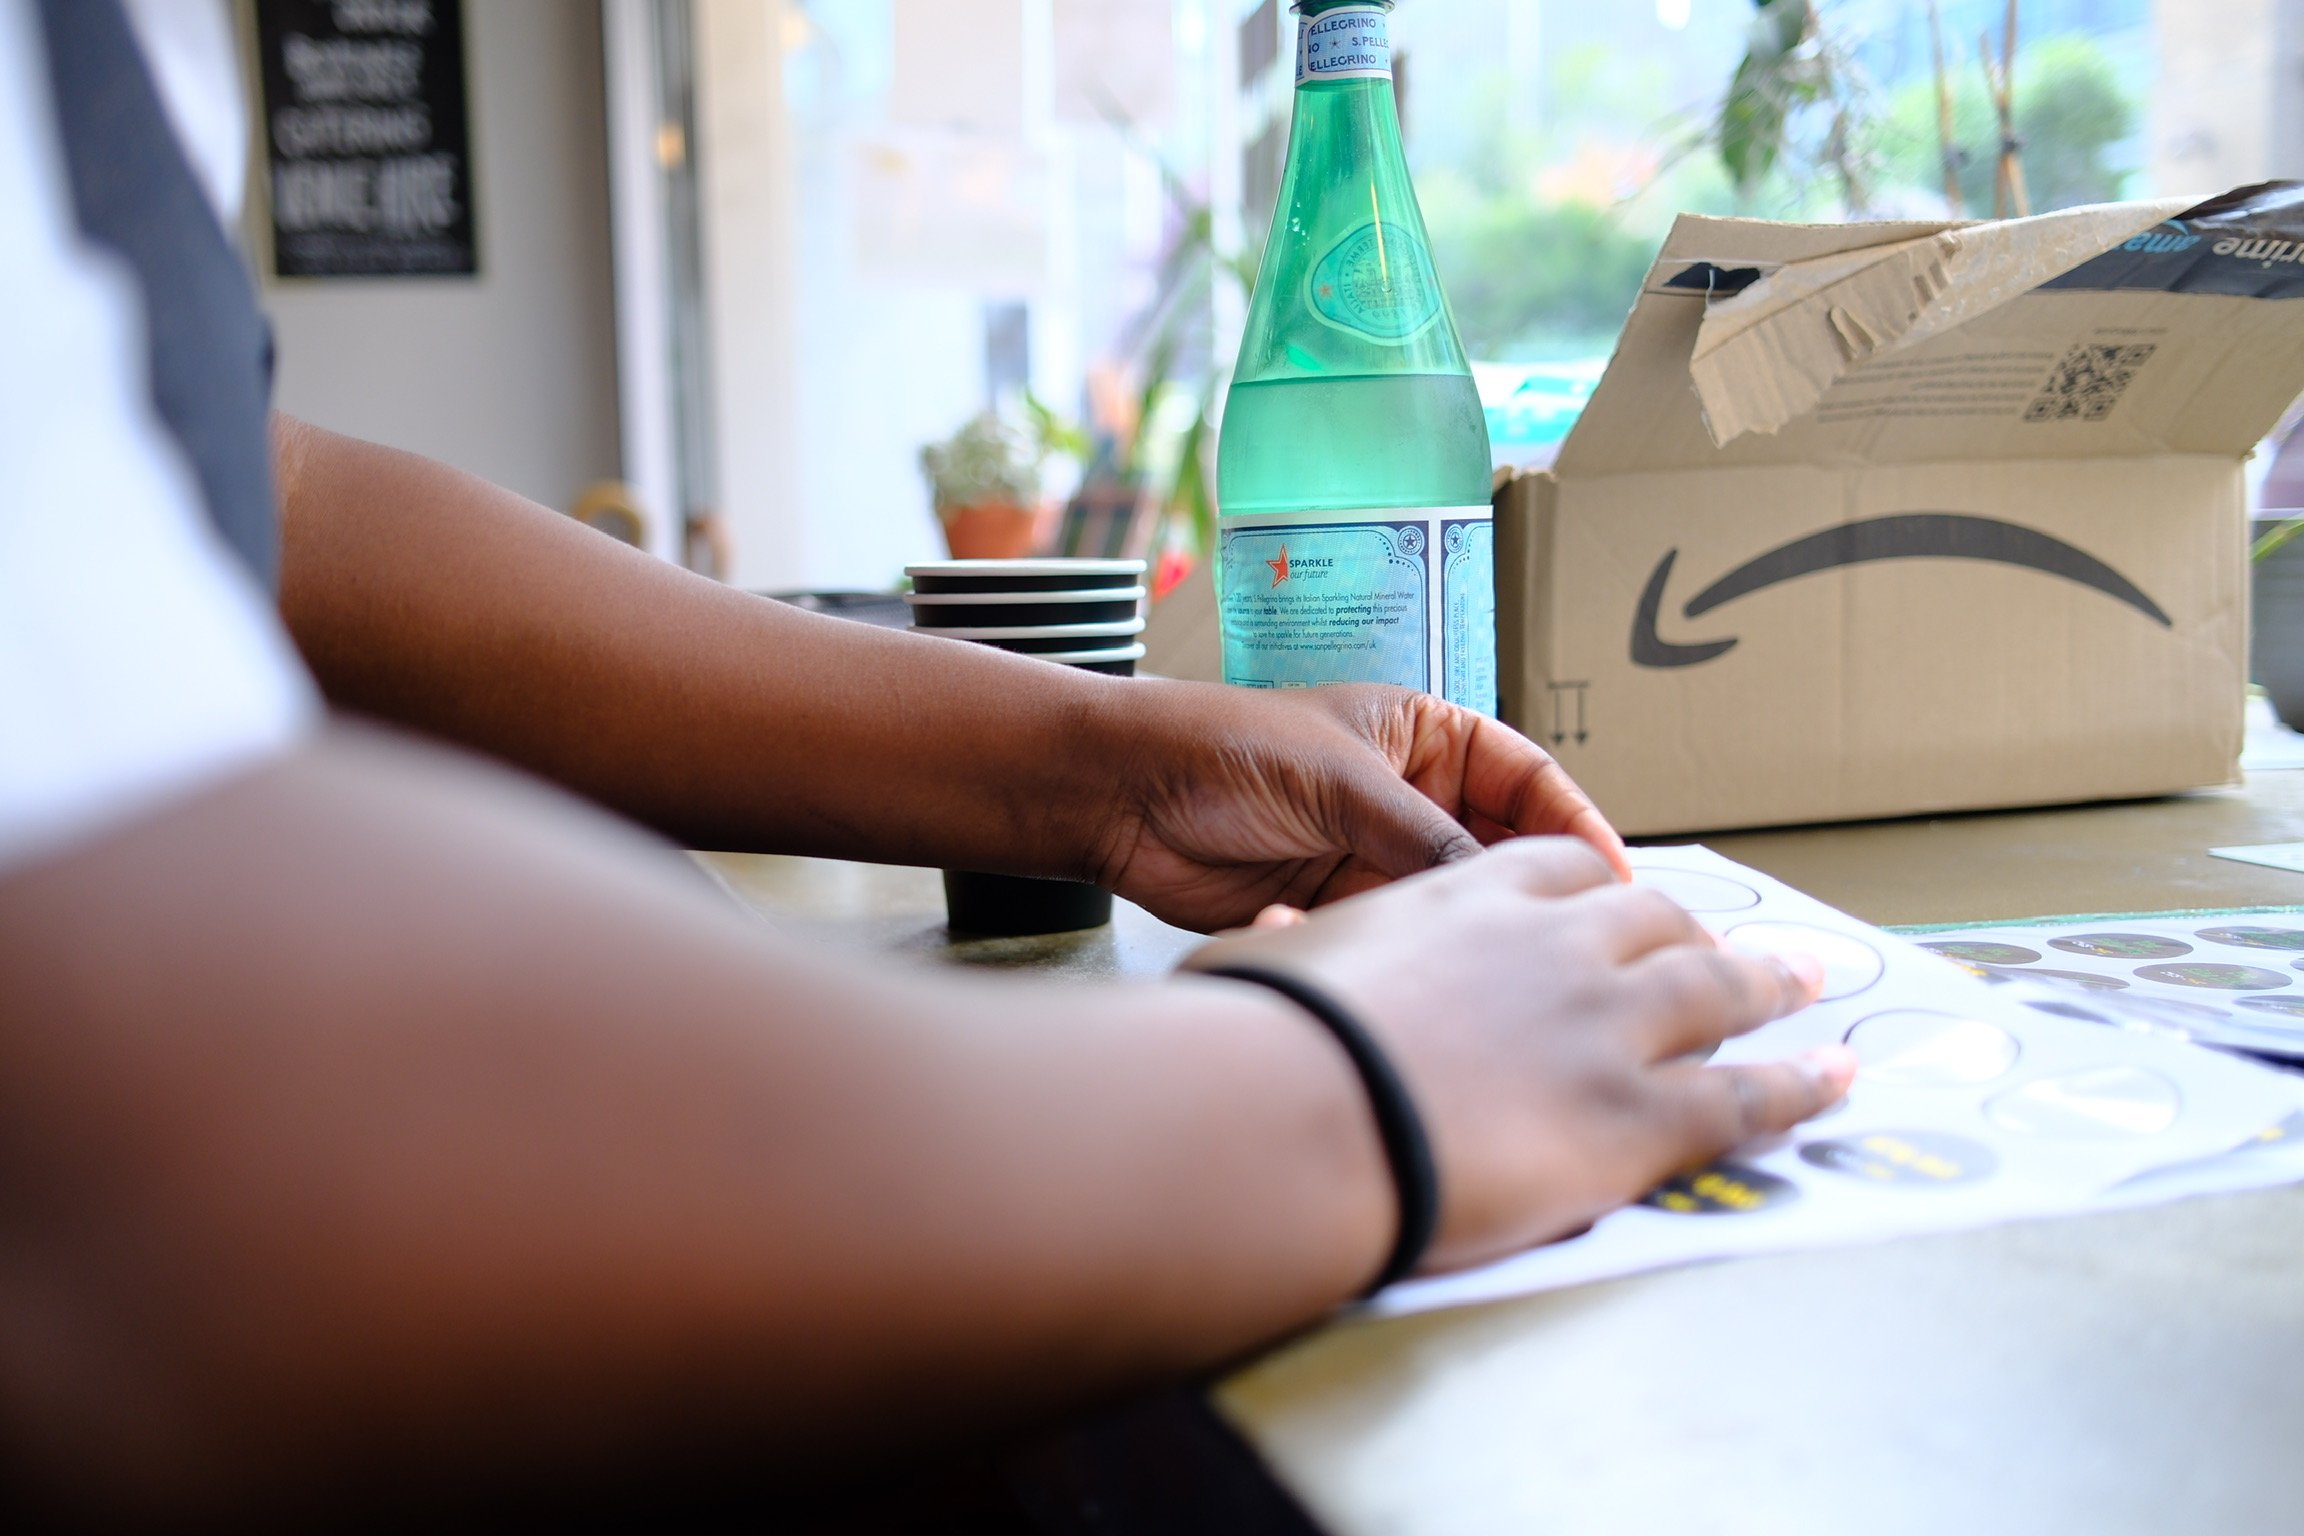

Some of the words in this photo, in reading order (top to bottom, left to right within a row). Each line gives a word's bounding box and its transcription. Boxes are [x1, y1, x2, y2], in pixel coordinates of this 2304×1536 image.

[1290, 558, 1334, 568] SPARKLE
[1290, 571, 1303, 579] our
[1303, 569, 1328, 581] future
[1278, 594, 1294, 605] brings
[1303, 593, 1320, 602] Italian
[1322, 592, 1348, 603] Sparkling
[1350, 591, 1372, 601] Natural
[1374, 590, 1396, 600] Mineral
[1397, 590, 1414, 599] Water
[1300, 605, 1327, 615] dedicated
[1335, 604, 1371, 616] protecting
[1373, 603, 1382, 612] this
[1384, 604, 1408, 614] precious
[1311, 617, 1327, 626] whilst
[1329, 617, 1359, 627] reducing
[1376, 616, 1399, 627] impact
[1302, 629, 1318, 638] future
